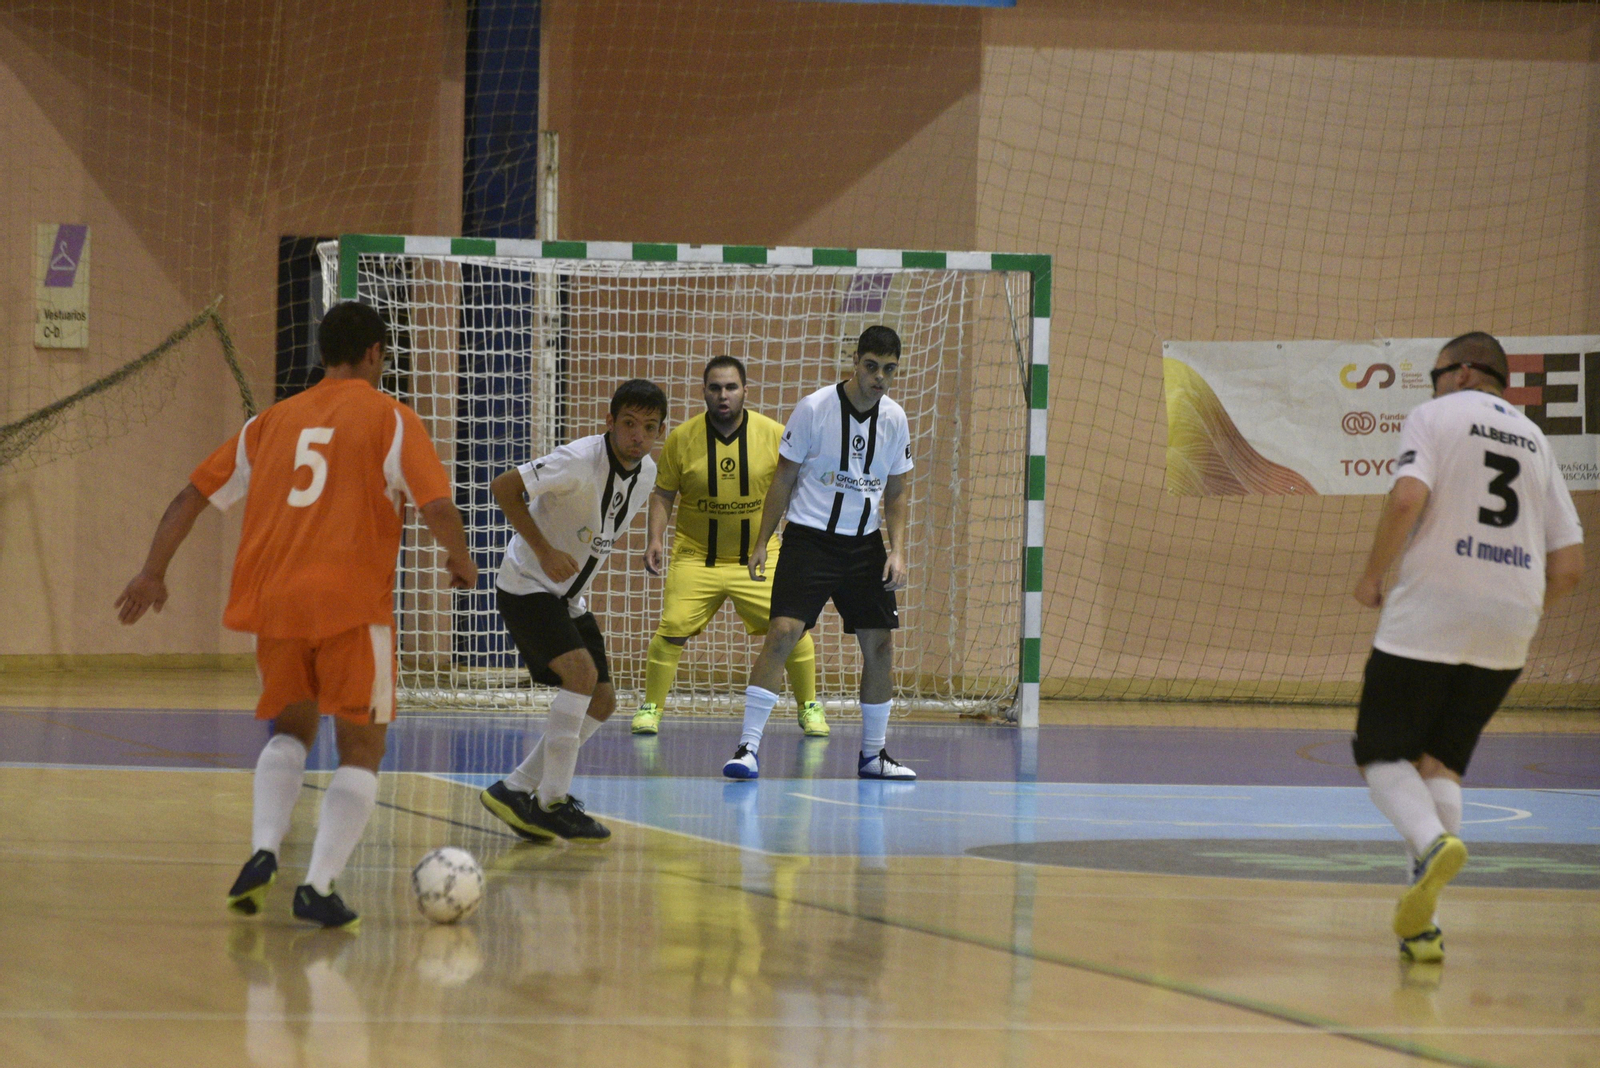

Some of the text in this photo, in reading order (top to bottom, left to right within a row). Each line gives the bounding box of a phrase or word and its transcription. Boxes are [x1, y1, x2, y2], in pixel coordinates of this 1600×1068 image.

[44, 308, 87, 321] Vestuarios
[43, 325, 60, 338] C-D
[1379, 422, 1404, 433] ON
[1470, 423, 1537, 453] ALBERTO
[286, 426, 335, 508] 5
[836, 473, 859, 486] Gran
[1478, 450, 1521, 529] 3
[708, 501, 730, 510] Gran
[1456, 535, 1532, 569] el muelle
